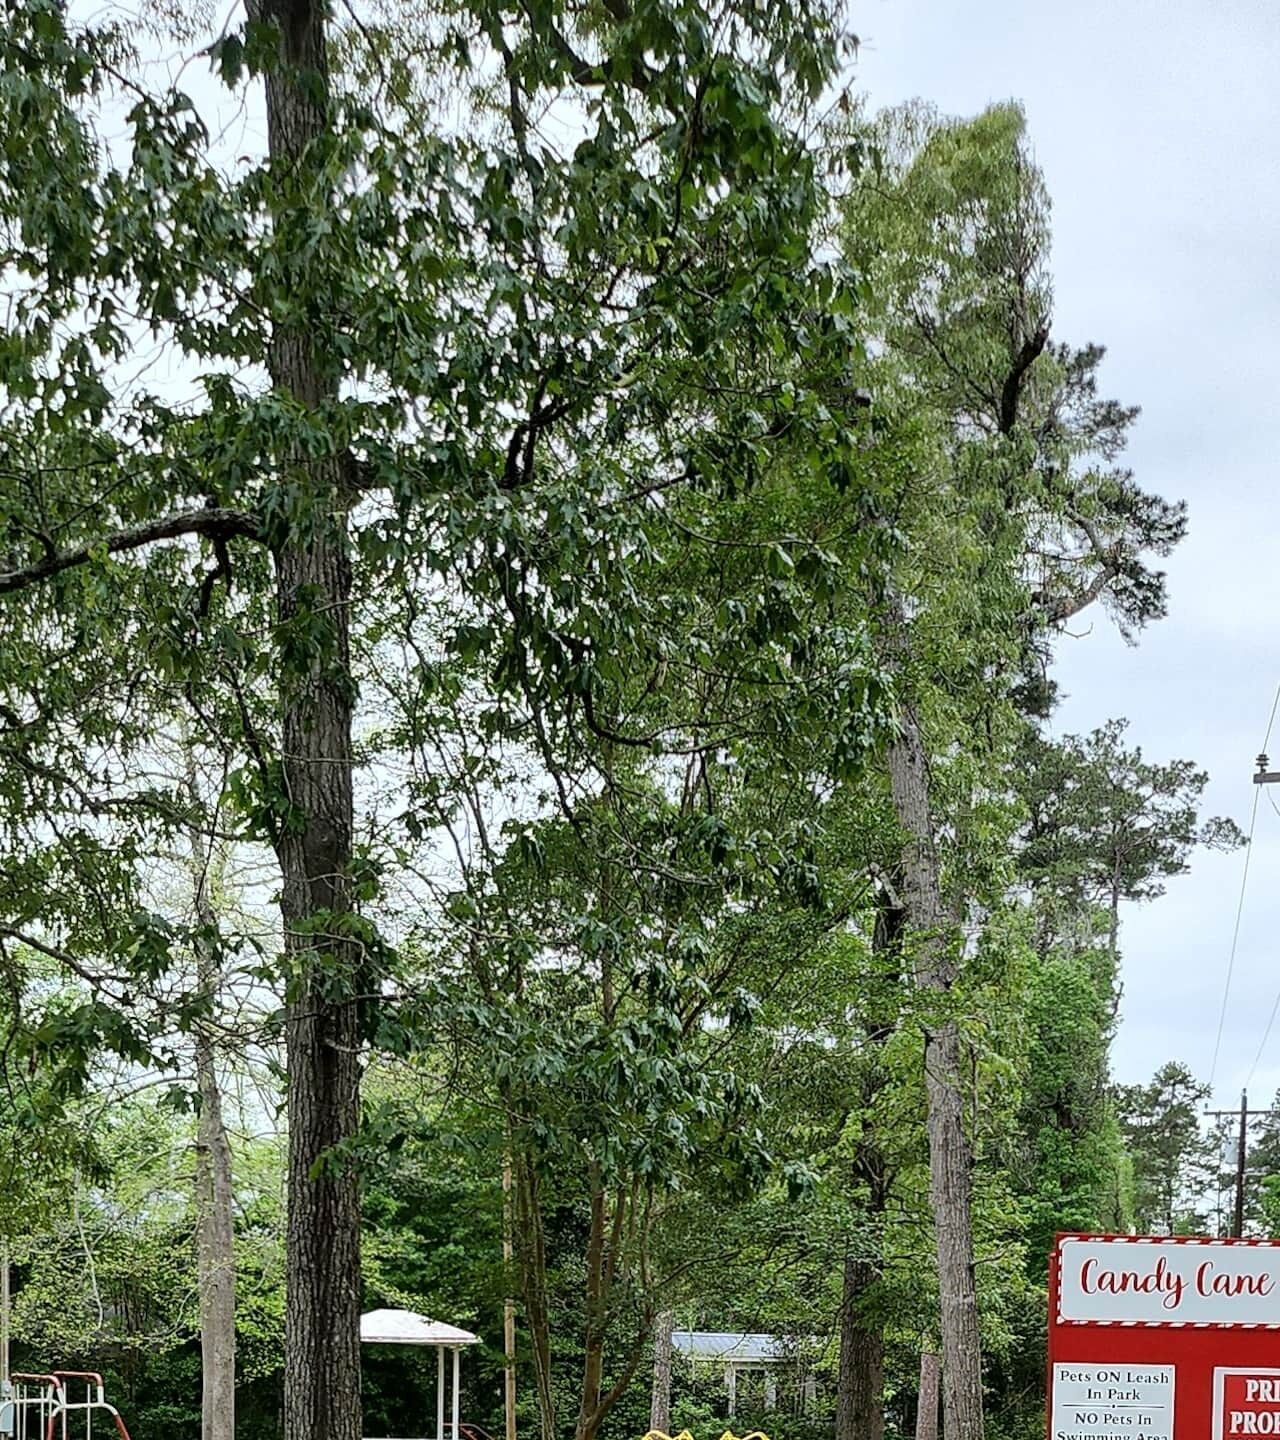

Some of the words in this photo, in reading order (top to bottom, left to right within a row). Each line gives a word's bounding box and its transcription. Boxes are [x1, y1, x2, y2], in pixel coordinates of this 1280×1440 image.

[1080, 1257, 1189, 1310] Candy
[1196, 1261, 1276, 1297] Cane
[1060, 1371, 1091, 1381] Pets
[1097, 1371, 1120, 1382] ON
[1127, 1372, 1169, 1383] Leash
[1087, 1389, 1101, 1399] In
[1108, 1389, 1141, 1400] Park
[1075, 1413, 1098, 1424] NO
[1104, 1414, 1132, 1424] Pets
[1138, 1414, 1151, 1424] In
